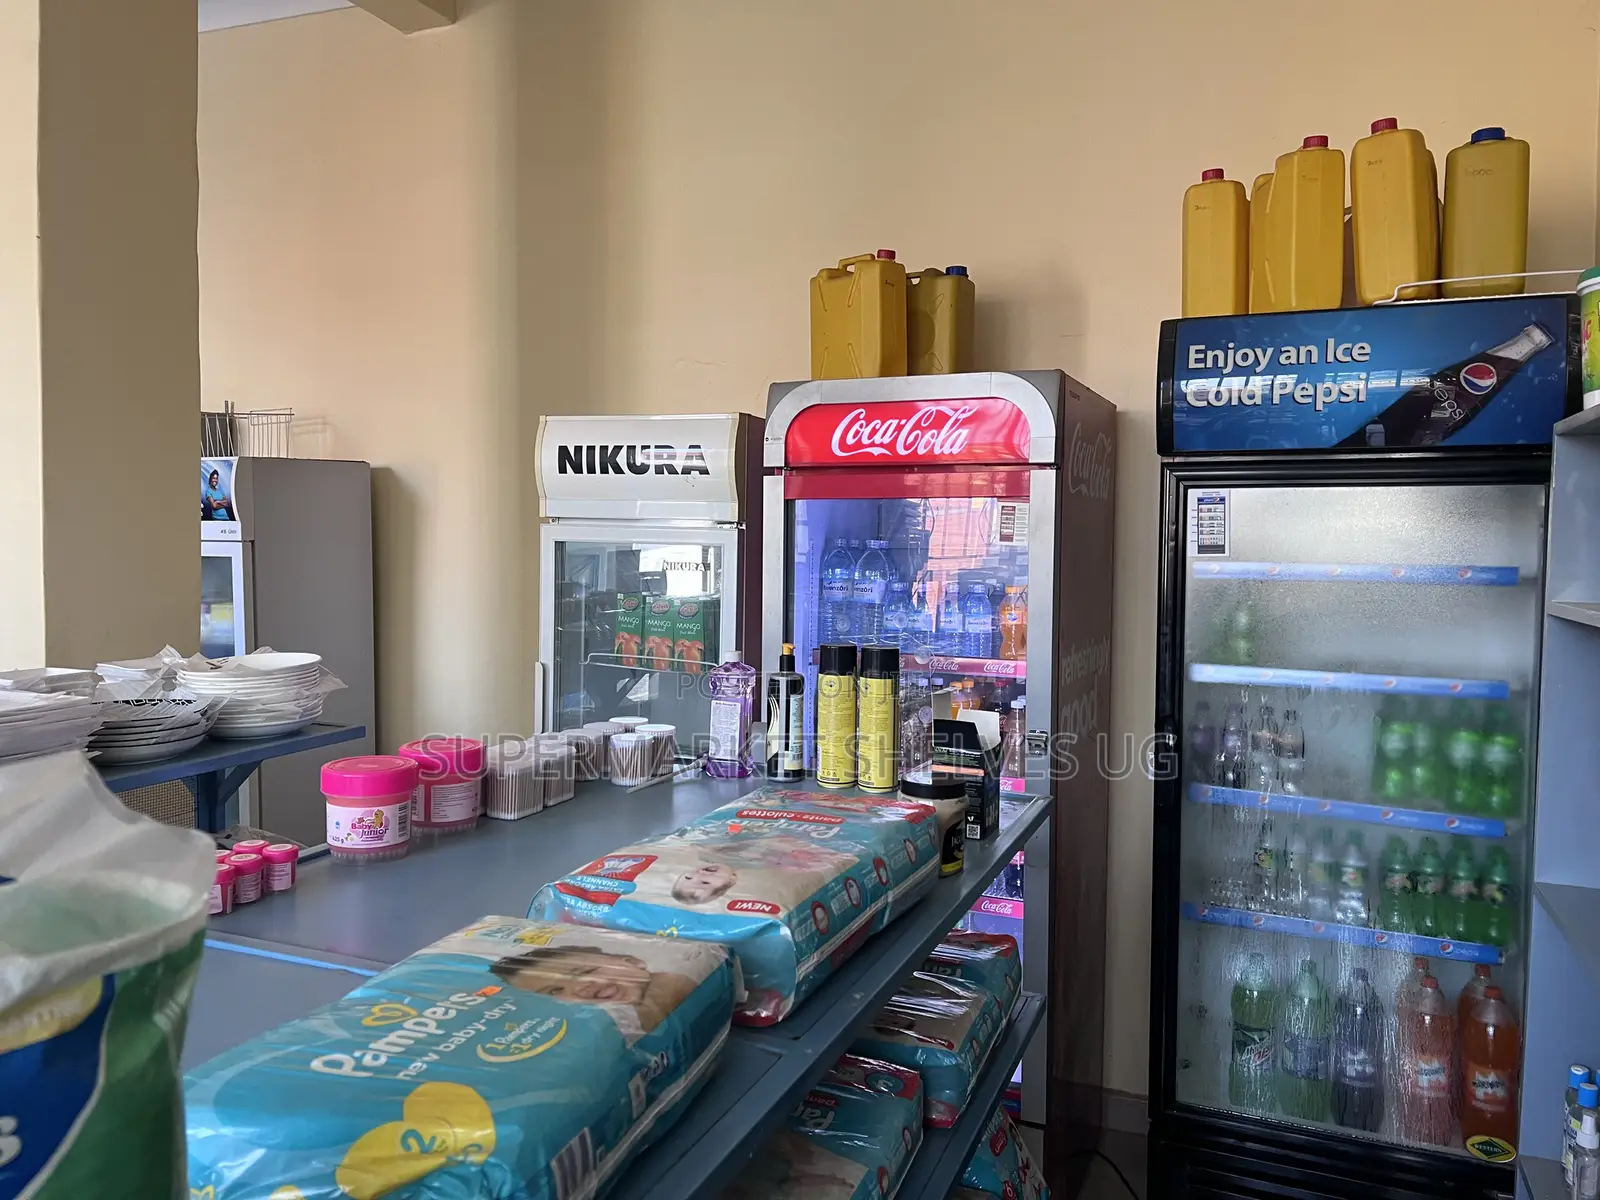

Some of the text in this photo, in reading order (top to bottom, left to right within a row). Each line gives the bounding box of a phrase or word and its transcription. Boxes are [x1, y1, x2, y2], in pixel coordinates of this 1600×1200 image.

[1187, 337, 1371, 374] Enjoy an Ice
[1186, 372, 1367, 411] Cold Pepsi
[831, 405, 980, 457] Coca-Cola
[558, 444, 711, 476] NIKURA
[618, 616, 640, 627] MANGO
[647, 620, 671, 630] MANGO
[676, 623, 701, 634] MANGO
[741, 809, 796, 819] culottes
[351, 822, 373, 830] Baby
[359, 828, 389, 839] Junior
[577, 875, 619, 887] CHANNELS
[733, 902, 772, 911] NEW!
[311, 991, 486, 1078] Pampers
[397, 999, 517, 1080] new baby-dry
[401, 1128, 437, 1155] 2
[1474, 1143, 1503, 1153] WESTERN
